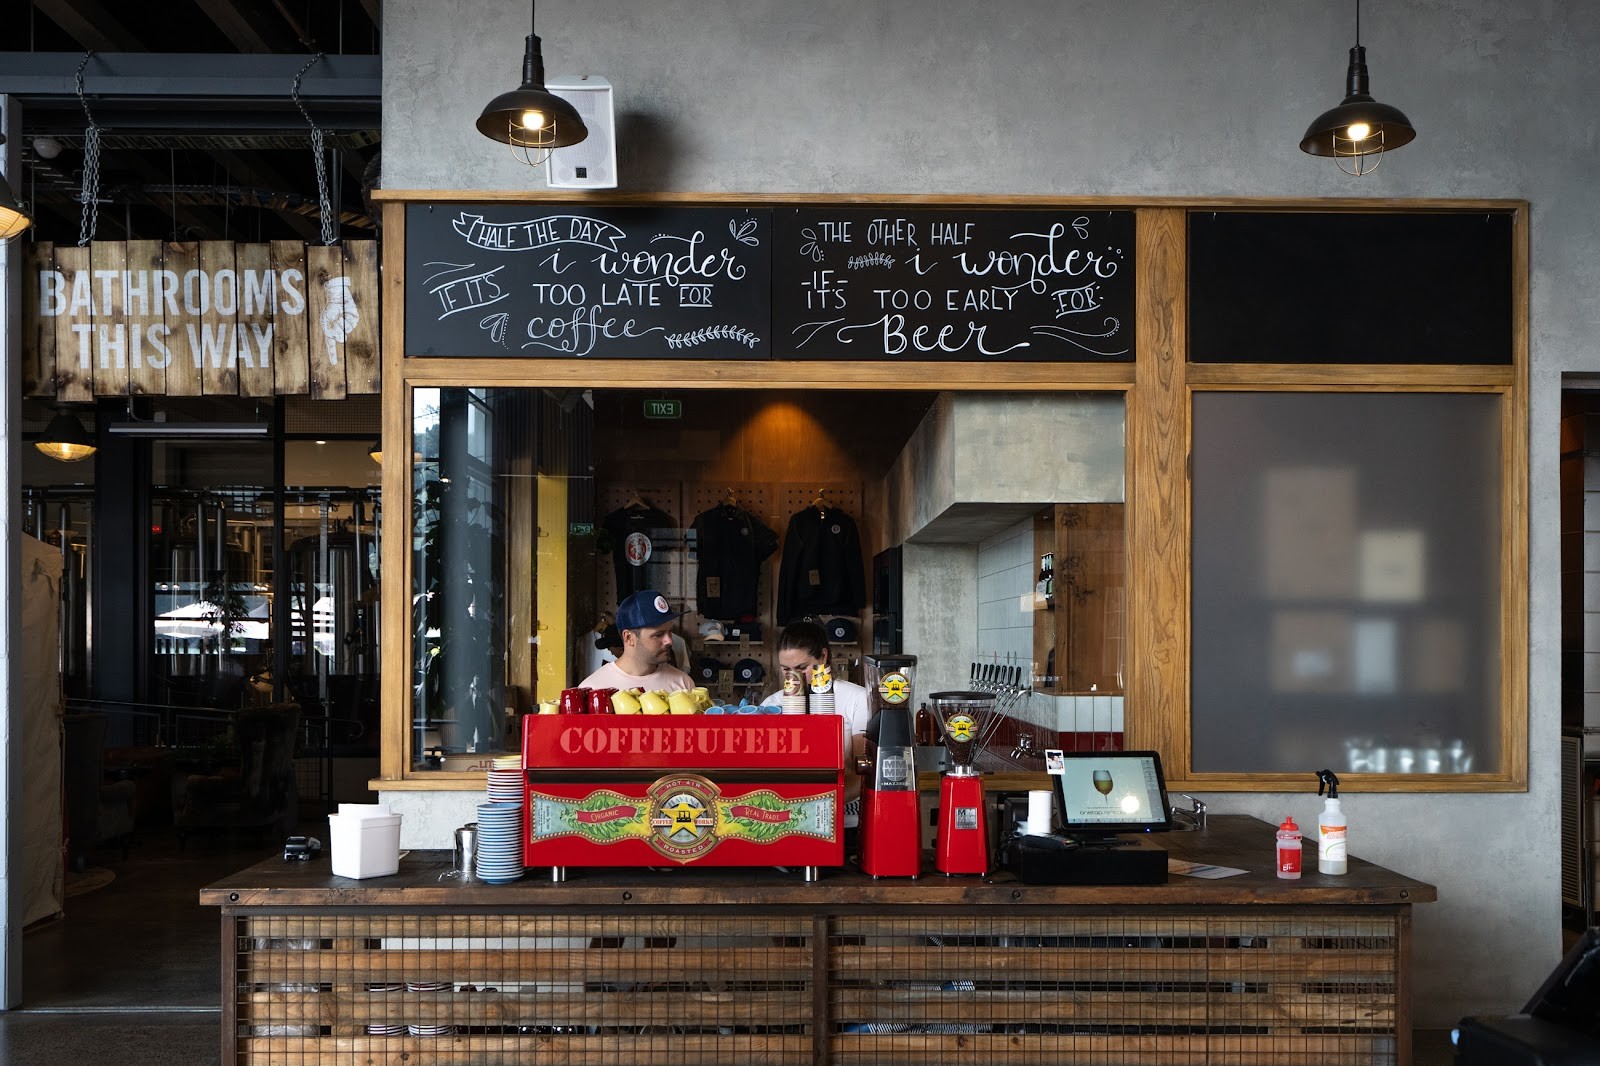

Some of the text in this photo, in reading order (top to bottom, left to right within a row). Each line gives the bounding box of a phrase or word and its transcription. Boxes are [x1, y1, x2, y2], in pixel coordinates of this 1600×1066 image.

[477, 218, 610, 248] HALF THE DAY
[818, 218, 975, 246] THE OTHER HALF
[591, 230, 746, 287] wonder
[952, 223, 1118, 295] wonder
[39, 268, 306, 317] BATHROOMS
[438, 274, 502, 313] IF IT'S
[532, 283, 713, 306] TOO LATE FOR
[874, 288, 1097, 312] TOO EARLY FOR
[521, 305, 665, 356] coffee
[837, 314, 1031, 355] Beer
[72, 323, 277, 369] THIS WAY
[560, 727, 809, 754] COFFEEUFEEL
[666, 780, 701, 789] HOT AIR
[590, 809, 619, 822] ORGANIC
[663, 844, 704, 855] ROASTED
